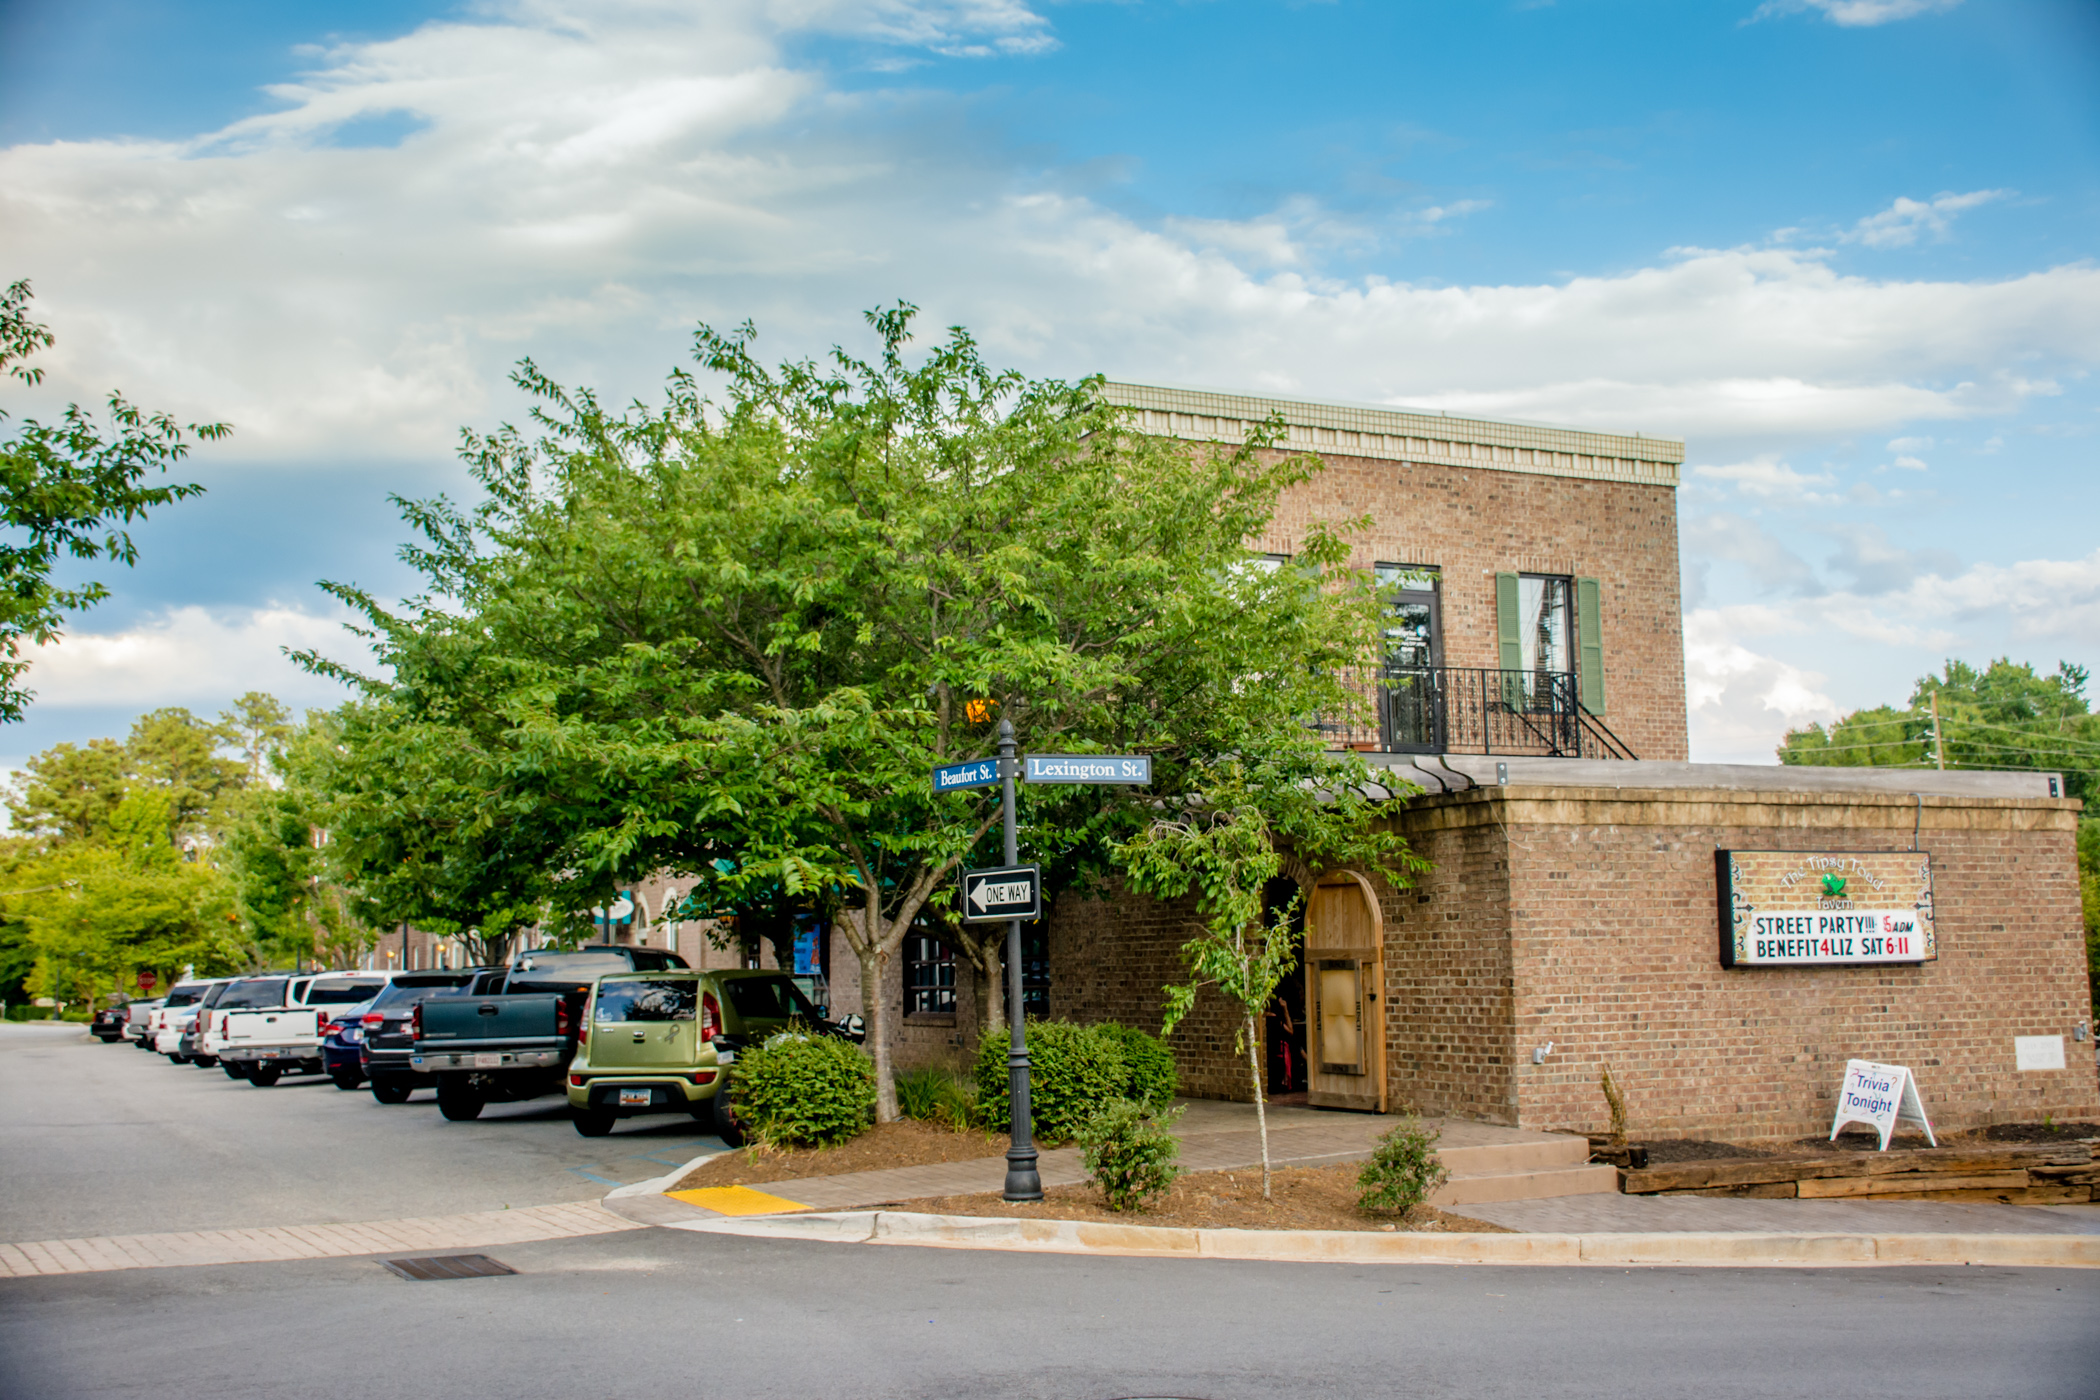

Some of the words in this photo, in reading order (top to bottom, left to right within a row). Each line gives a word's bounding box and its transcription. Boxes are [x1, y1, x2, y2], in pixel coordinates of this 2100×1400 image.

[940, 766, 977, 787] Beaufort
[979, 764, 992, 780] St.
[1033, 759, 1116, 779] Lexington
[1121, 760, 1143, 777] St.
[1780, 866, 1807, 889] The
[1806, 855, 1845, 872] Tipsy
[1849, 857, 1884, 891] Toad
[986, 884, 1005, 903] ONE
[1007, 881, 1028, 902] WAY
[1816, 896, 1854, 910] Tavern
[1756, 917, 1813, 935] STREET
[1819, 916, 1875, 934] PARTY!!!
[1861, 937, 1883, 955] SAT
[1857, 1074, 1890, 1092] Trivia
[1847, 1092, 1892, 1113] Tonight
